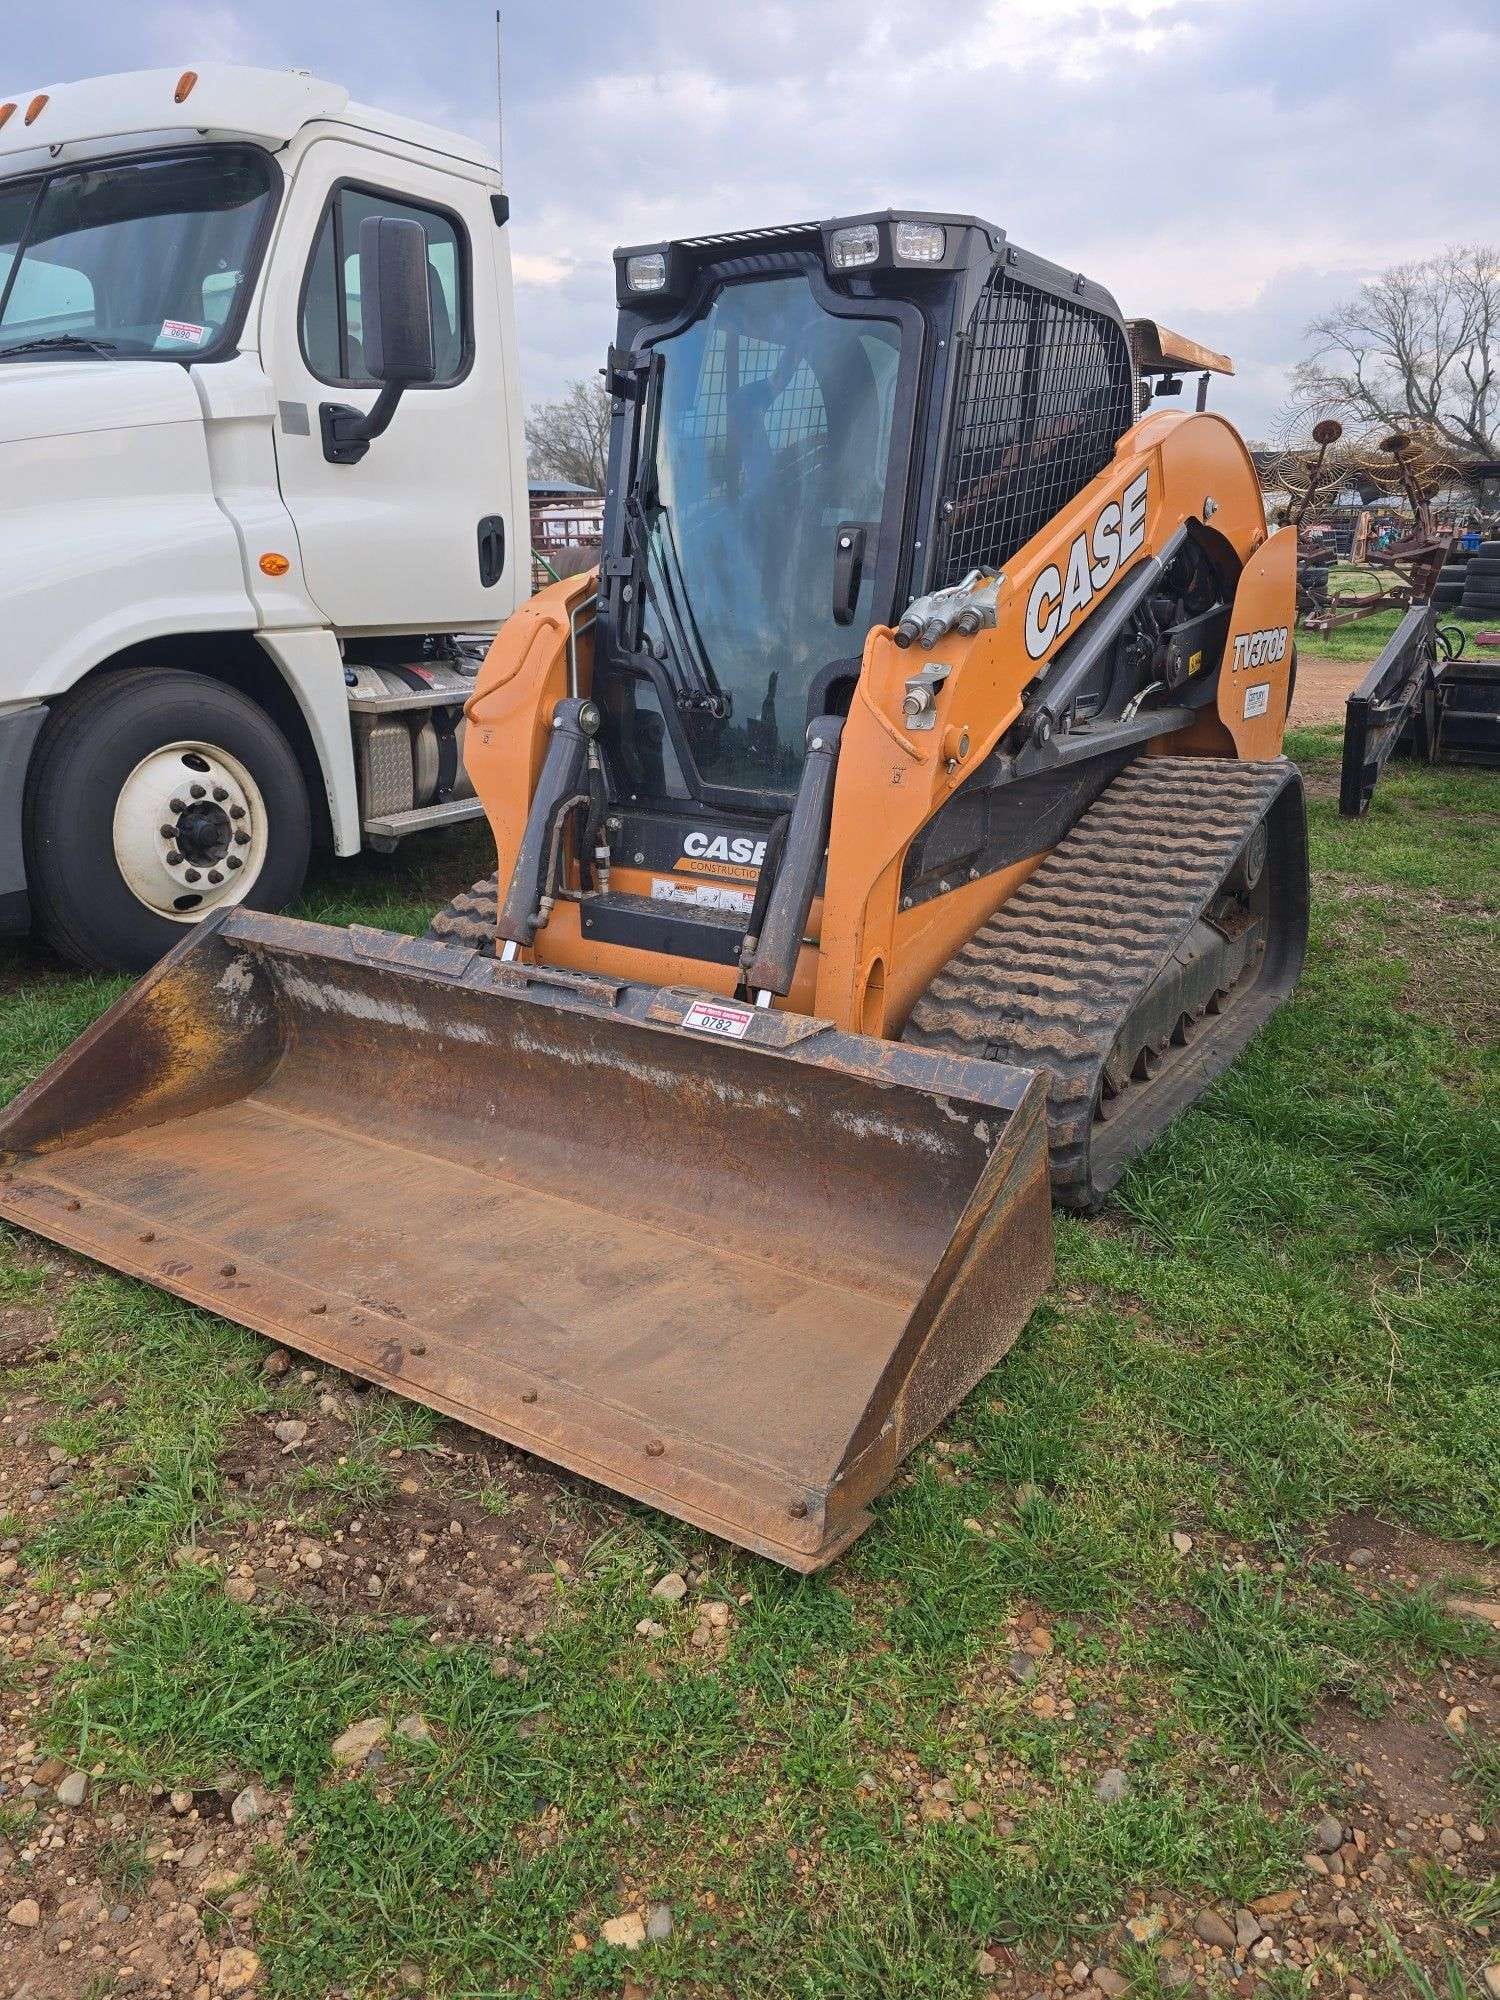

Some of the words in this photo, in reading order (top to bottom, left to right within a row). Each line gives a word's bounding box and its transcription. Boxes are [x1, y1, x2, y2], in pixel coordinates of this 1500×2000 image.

[1025, 470, 1148, 660] CASE
[1232, 626, 1288, 673] TV370B
[683, 832, 767, 865] CASE
[690, 861, 759, 879] CONSTRUCTIO
[701, 1016, 731, 1031] 0782
